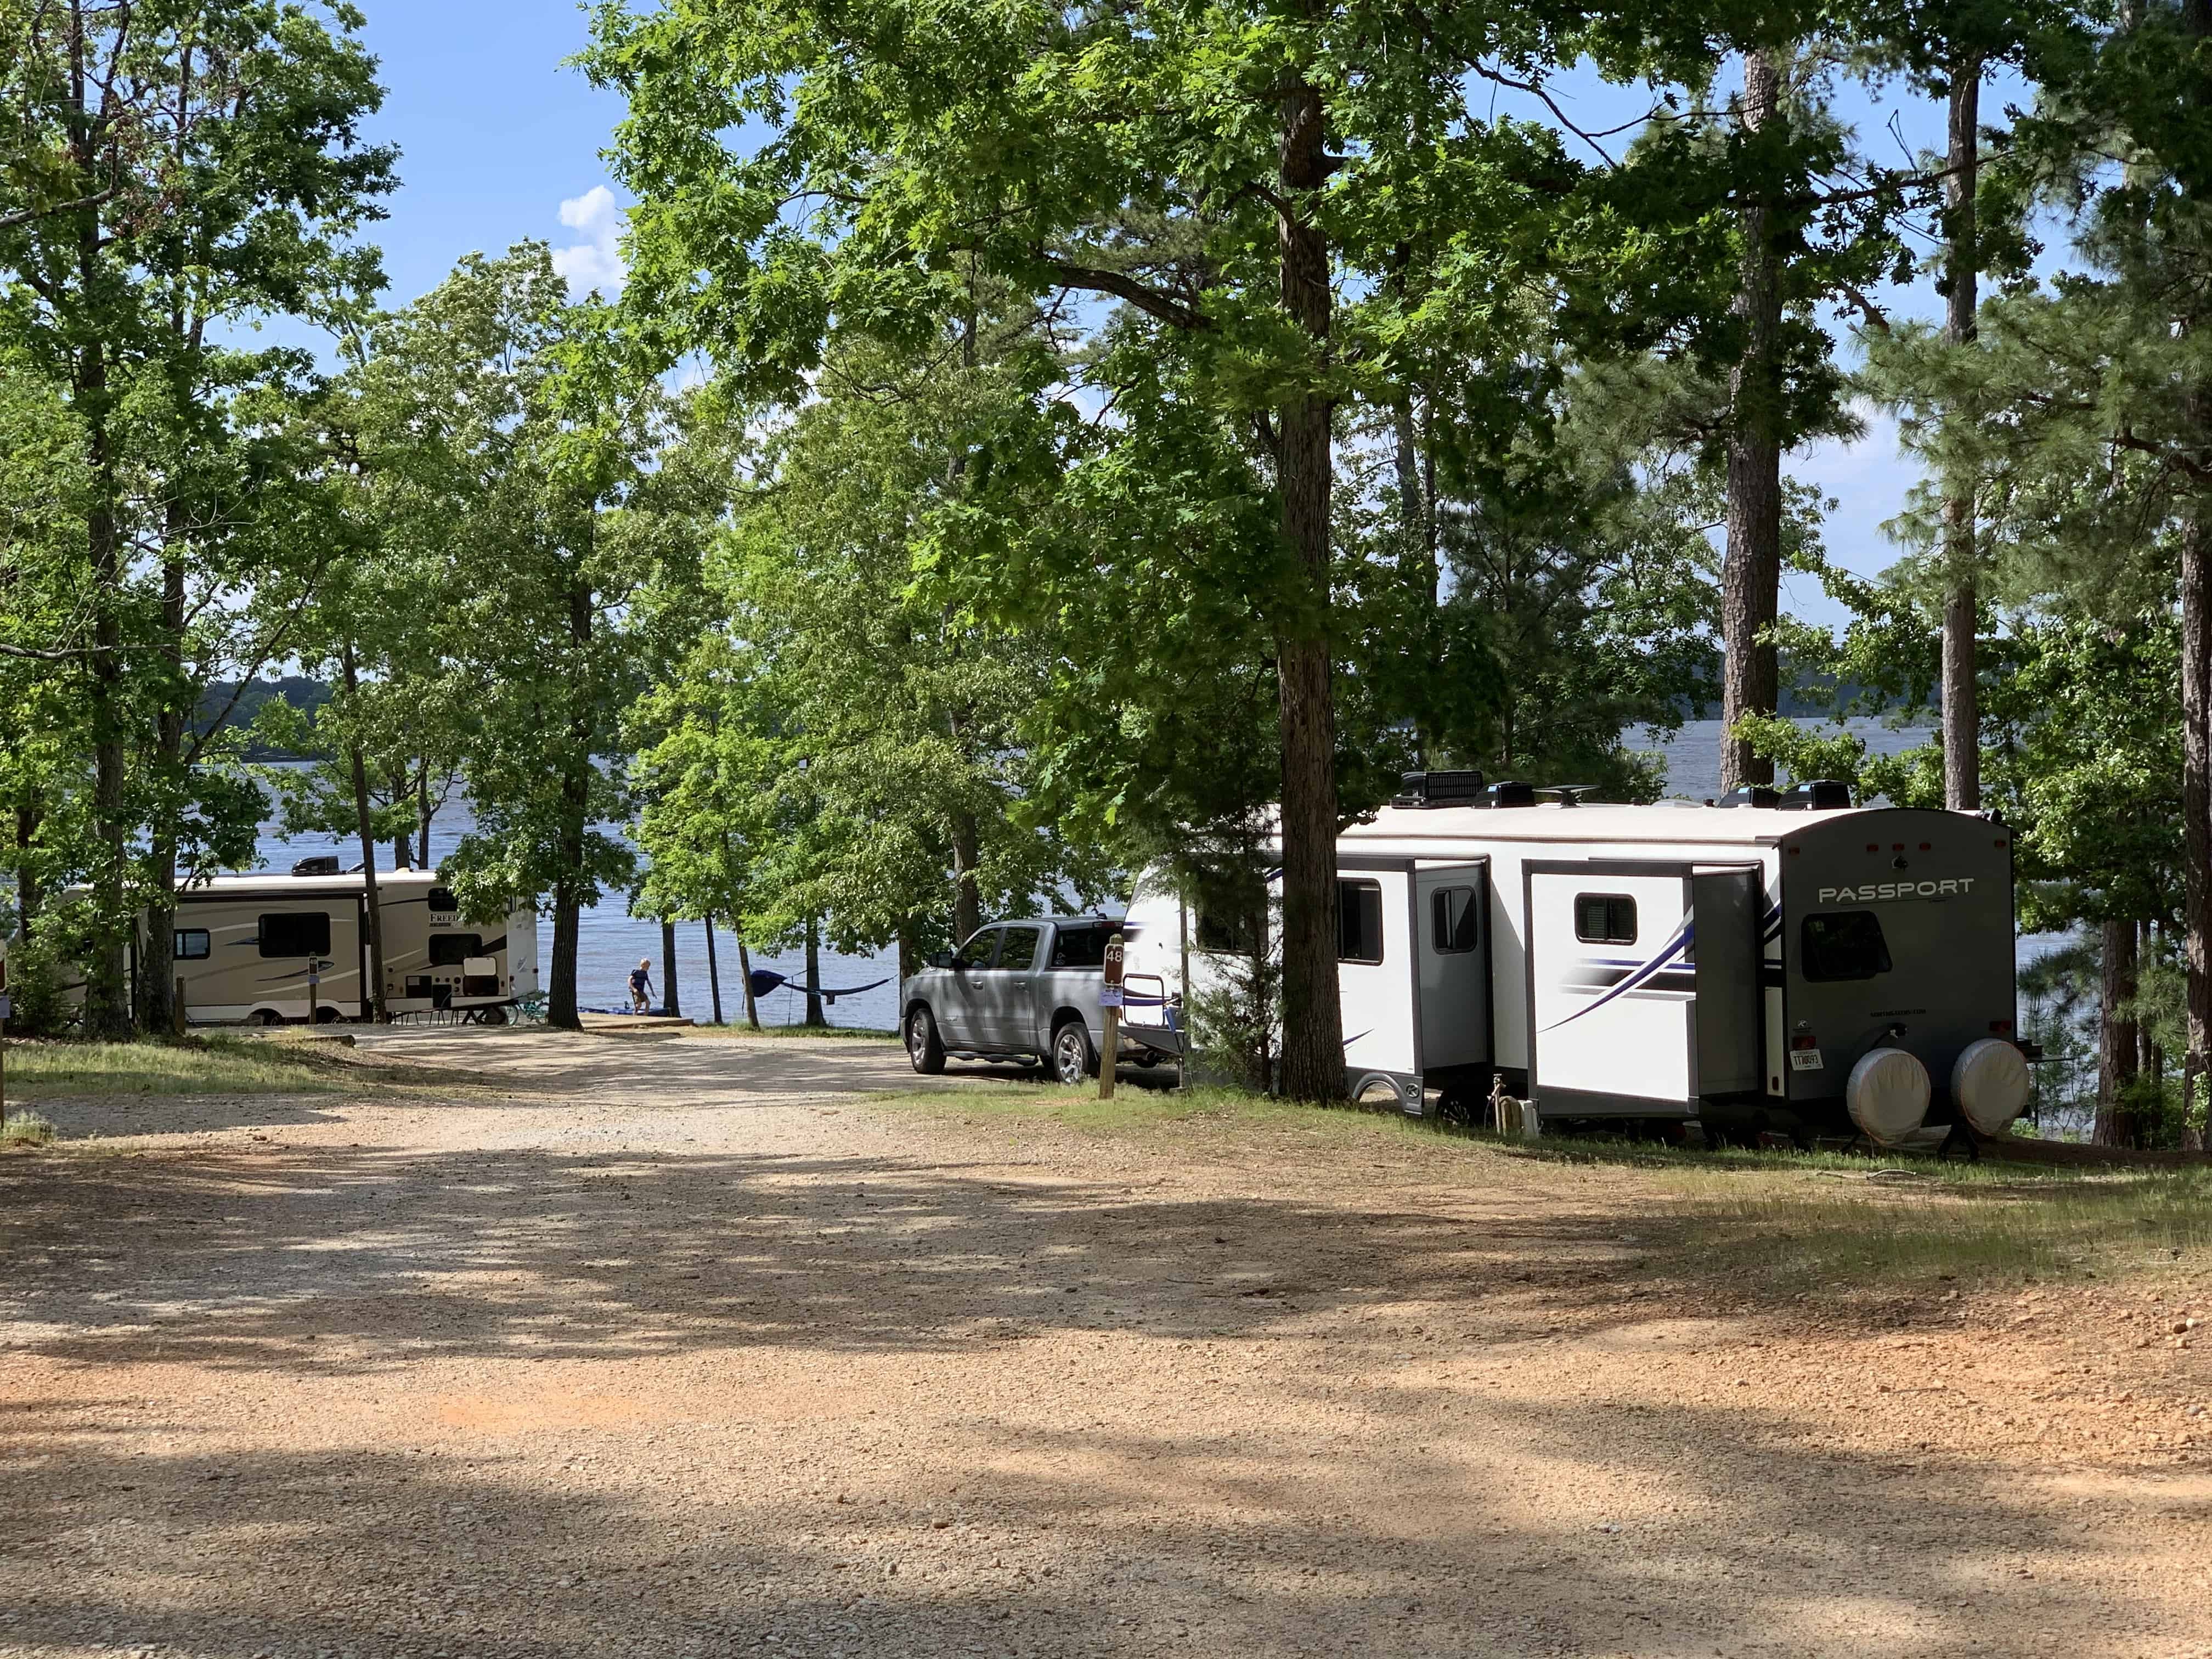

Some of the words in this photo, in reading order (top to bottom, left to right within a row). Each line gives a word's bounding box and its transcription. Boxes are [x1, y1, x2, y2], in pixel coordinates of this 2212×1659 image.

[1818, 878, 1975, 904] PASSPORT
[430, 913, 458, 922] FREED
[1106, 950, 1122, 962] 48
